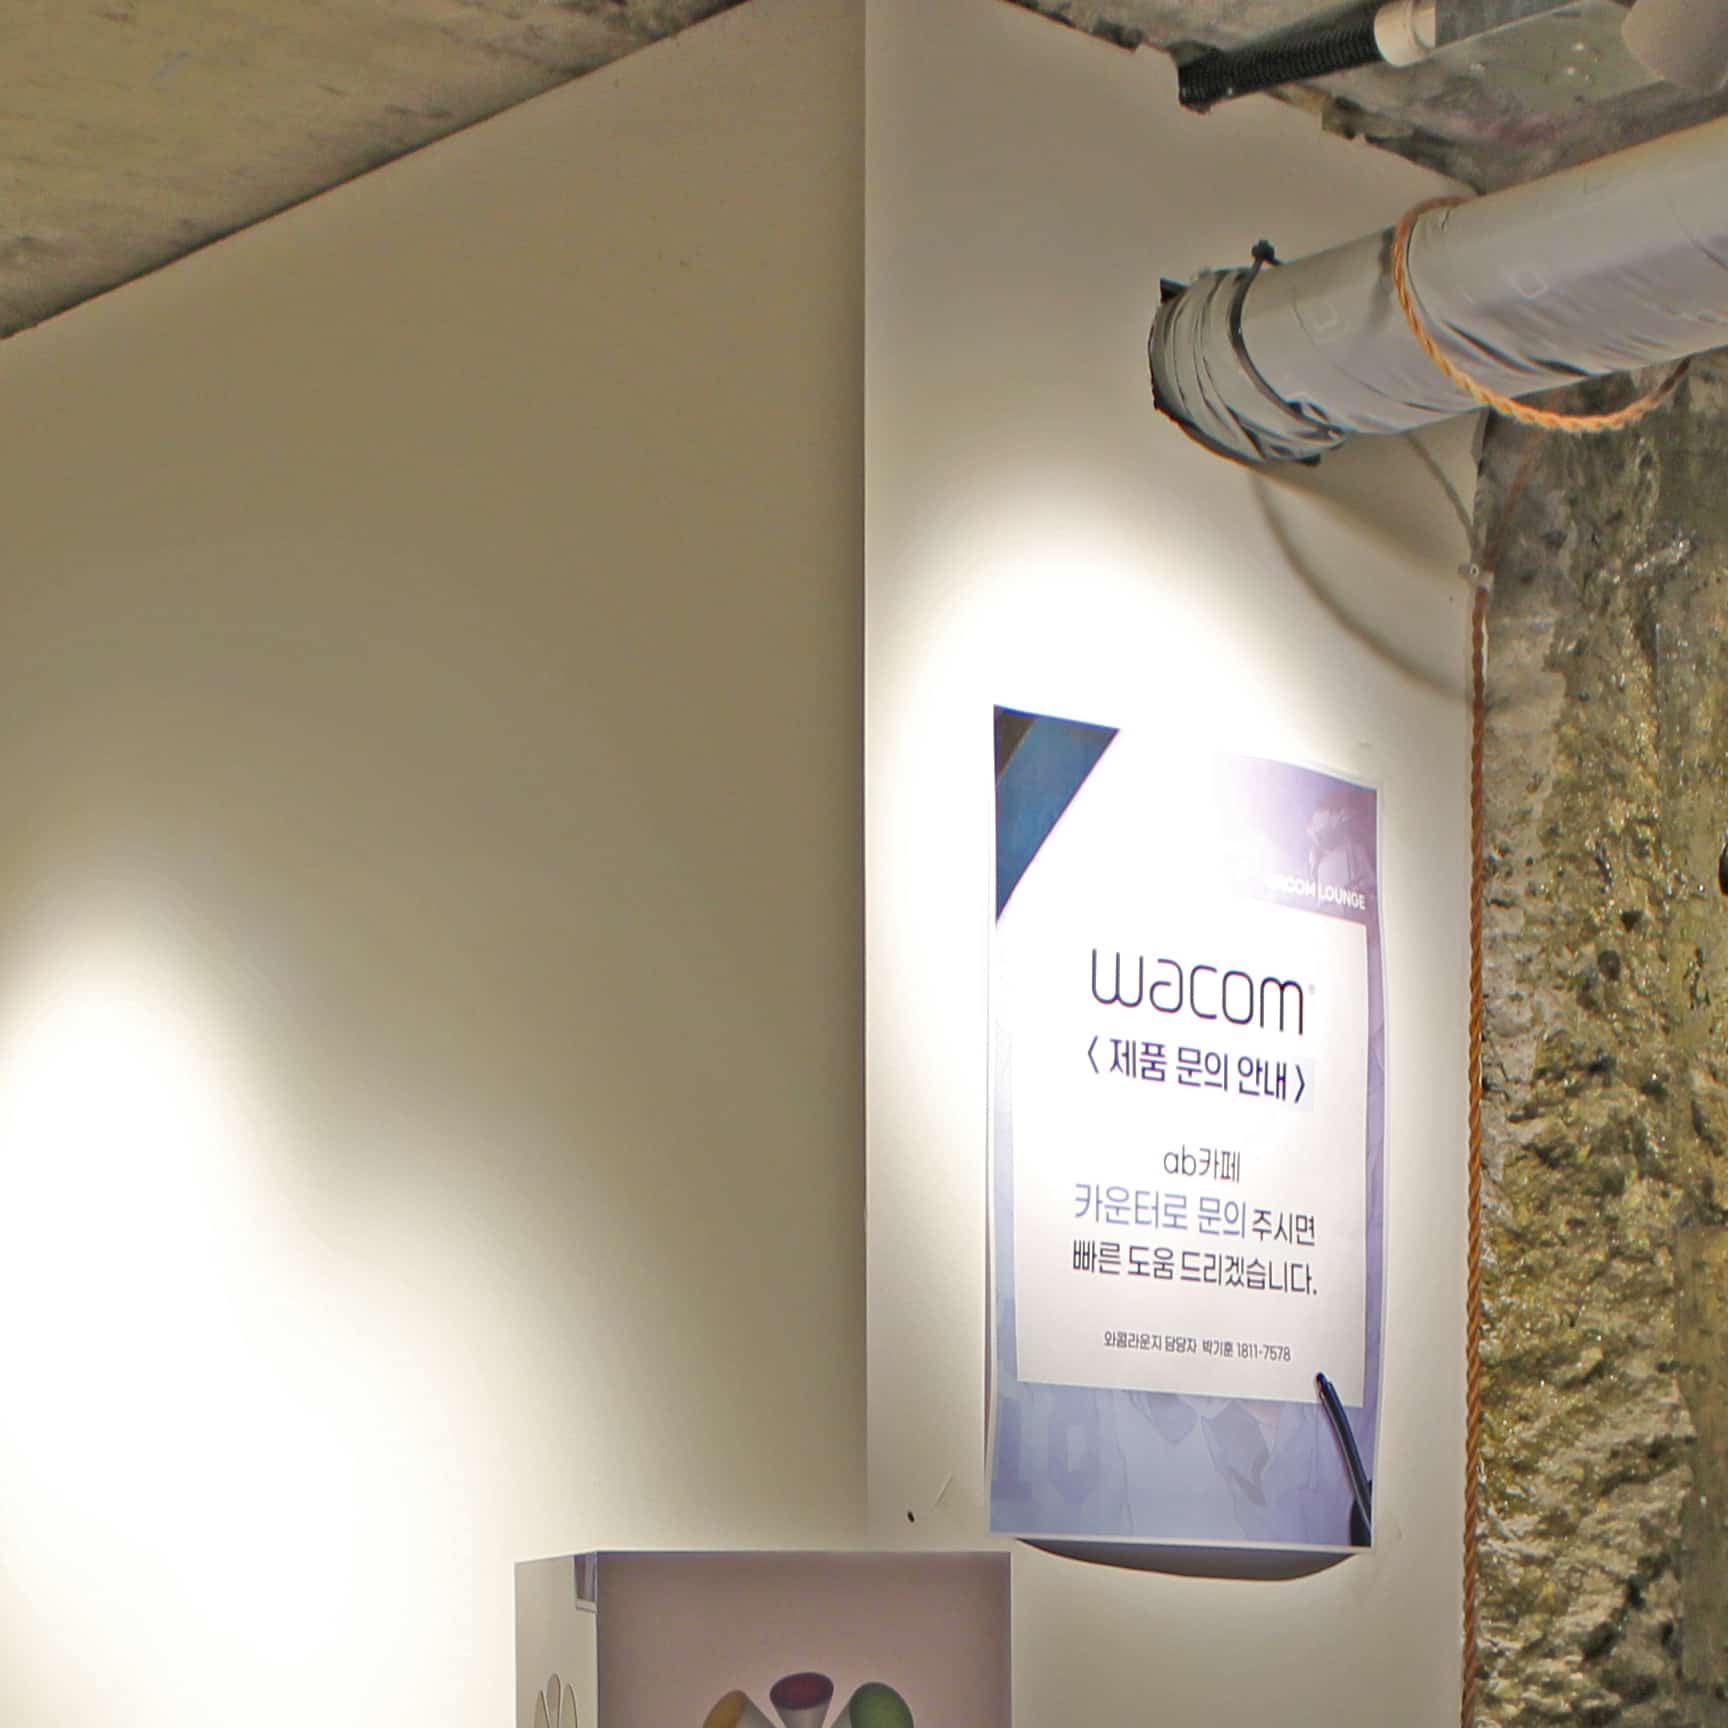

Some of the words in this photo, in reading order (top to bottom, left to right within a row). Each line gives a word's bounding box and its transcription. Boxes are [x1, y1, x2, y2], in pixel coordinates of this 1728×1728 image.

[1318, 882, 1366, 911] LOUNGE
[1091, 948, 1304, 1036] wacom
[1110, 1037, 1168, 1083] 제품
[1176, 1046, 1229, 1092] 문의
[1237, 1055, 1288, 1102] 안내
[1163, 1144, 1241, 1184] ab카페
[1074, 1183, 1188, 1230] 카운터로
[1197, 1195, 1247, 1239] 문의
[1251, 1208, 1316, 1248] 주시면
[1072, 1239, 1122, 1276] 빠른
[1128, 1244, 1176, 1281] 도움
[1180, 1249, 1318, 1296] 드리겠습니다.
[1164, 1335, 1197, 1355] 담당자
[1237, 1342, 1292, 1362] 1811-7578
